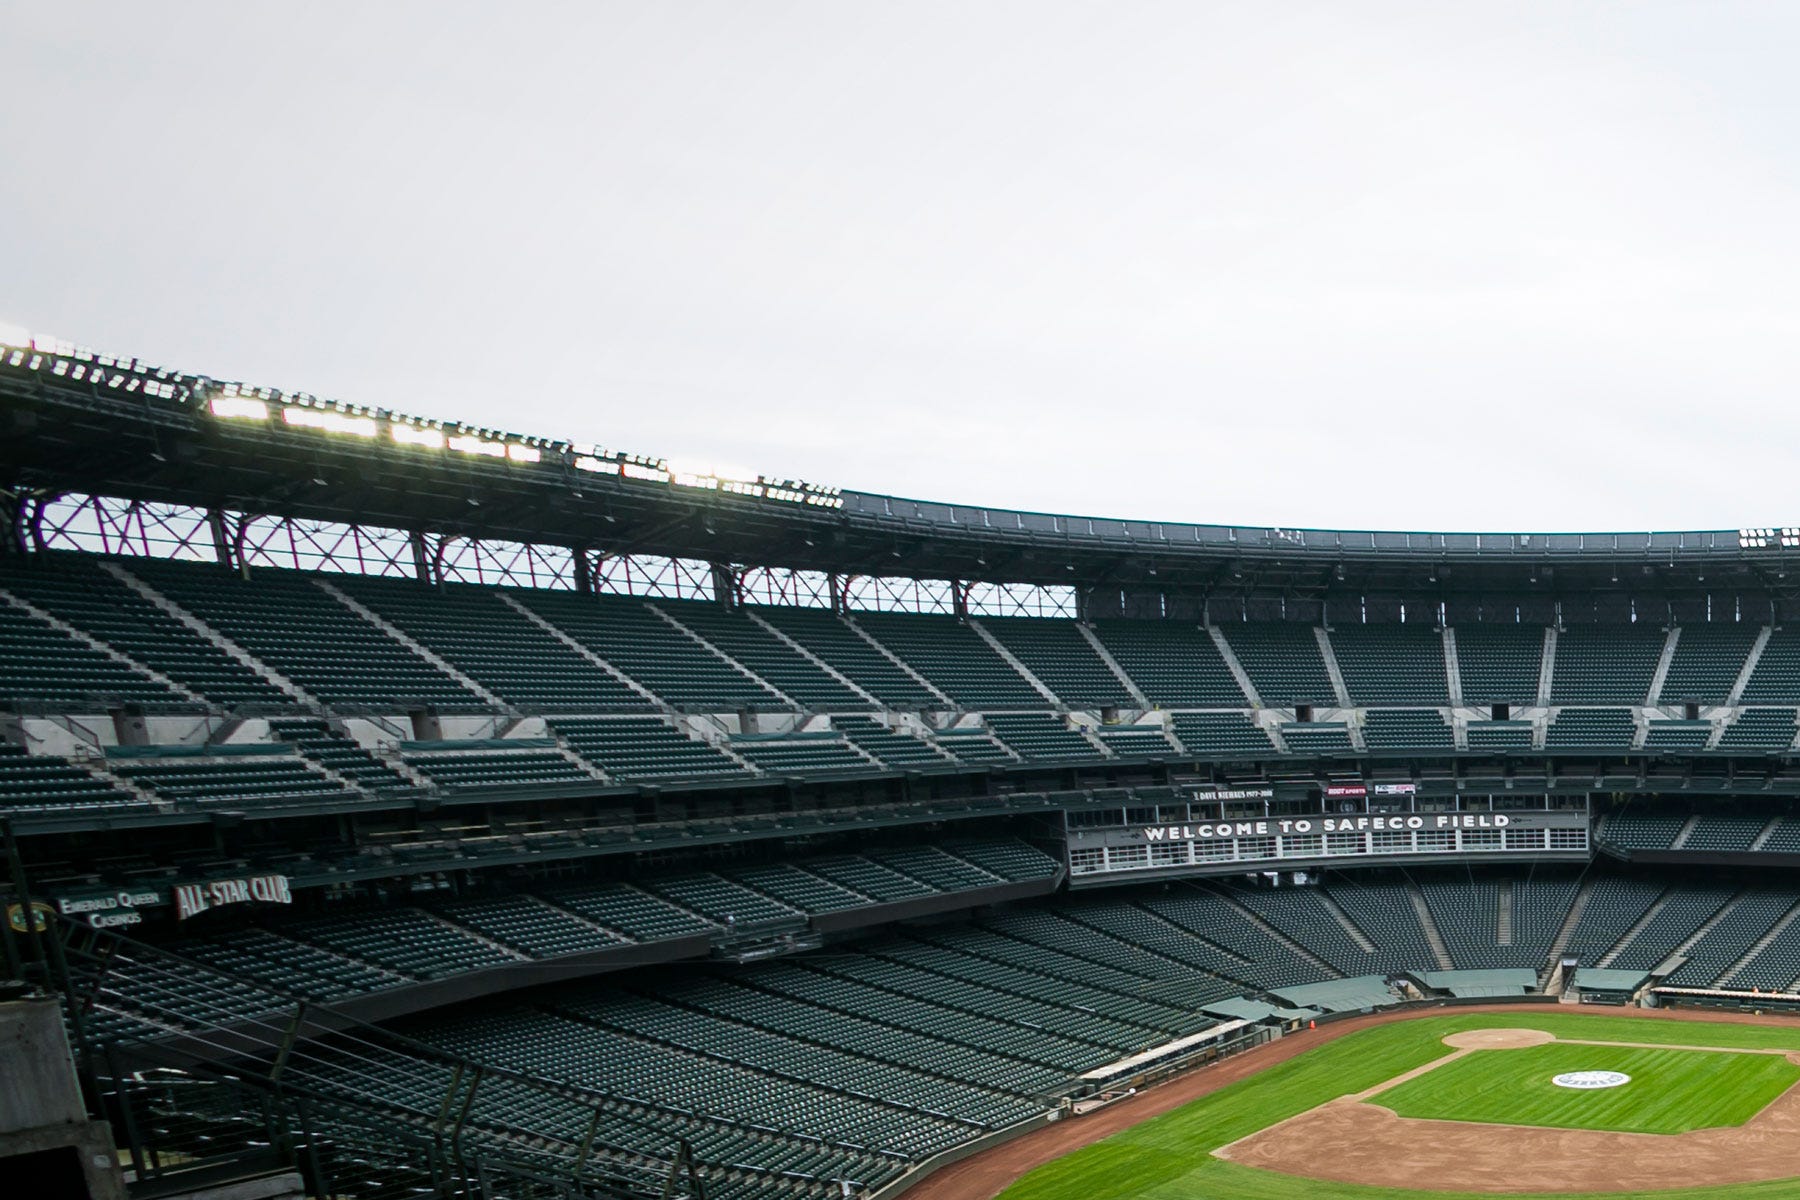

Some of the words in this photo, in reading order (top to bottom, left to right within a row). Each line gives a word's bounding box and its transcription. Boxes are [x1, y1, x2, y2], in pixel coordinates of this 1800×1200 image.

[1145, 821, 1269, 841] WELCOME
[1279, 819, 1312, 833] TO
[1324, 815, 1425, 832] SAFECO
[1436, 814, 1510, 829] FIELD
[250, 875, 293, 904] CLUB
[59, 897, 117, 915] EMERALD
[118, 892, 160, 908] QUEEN
[90, 912, 142, 929] CASINOS
